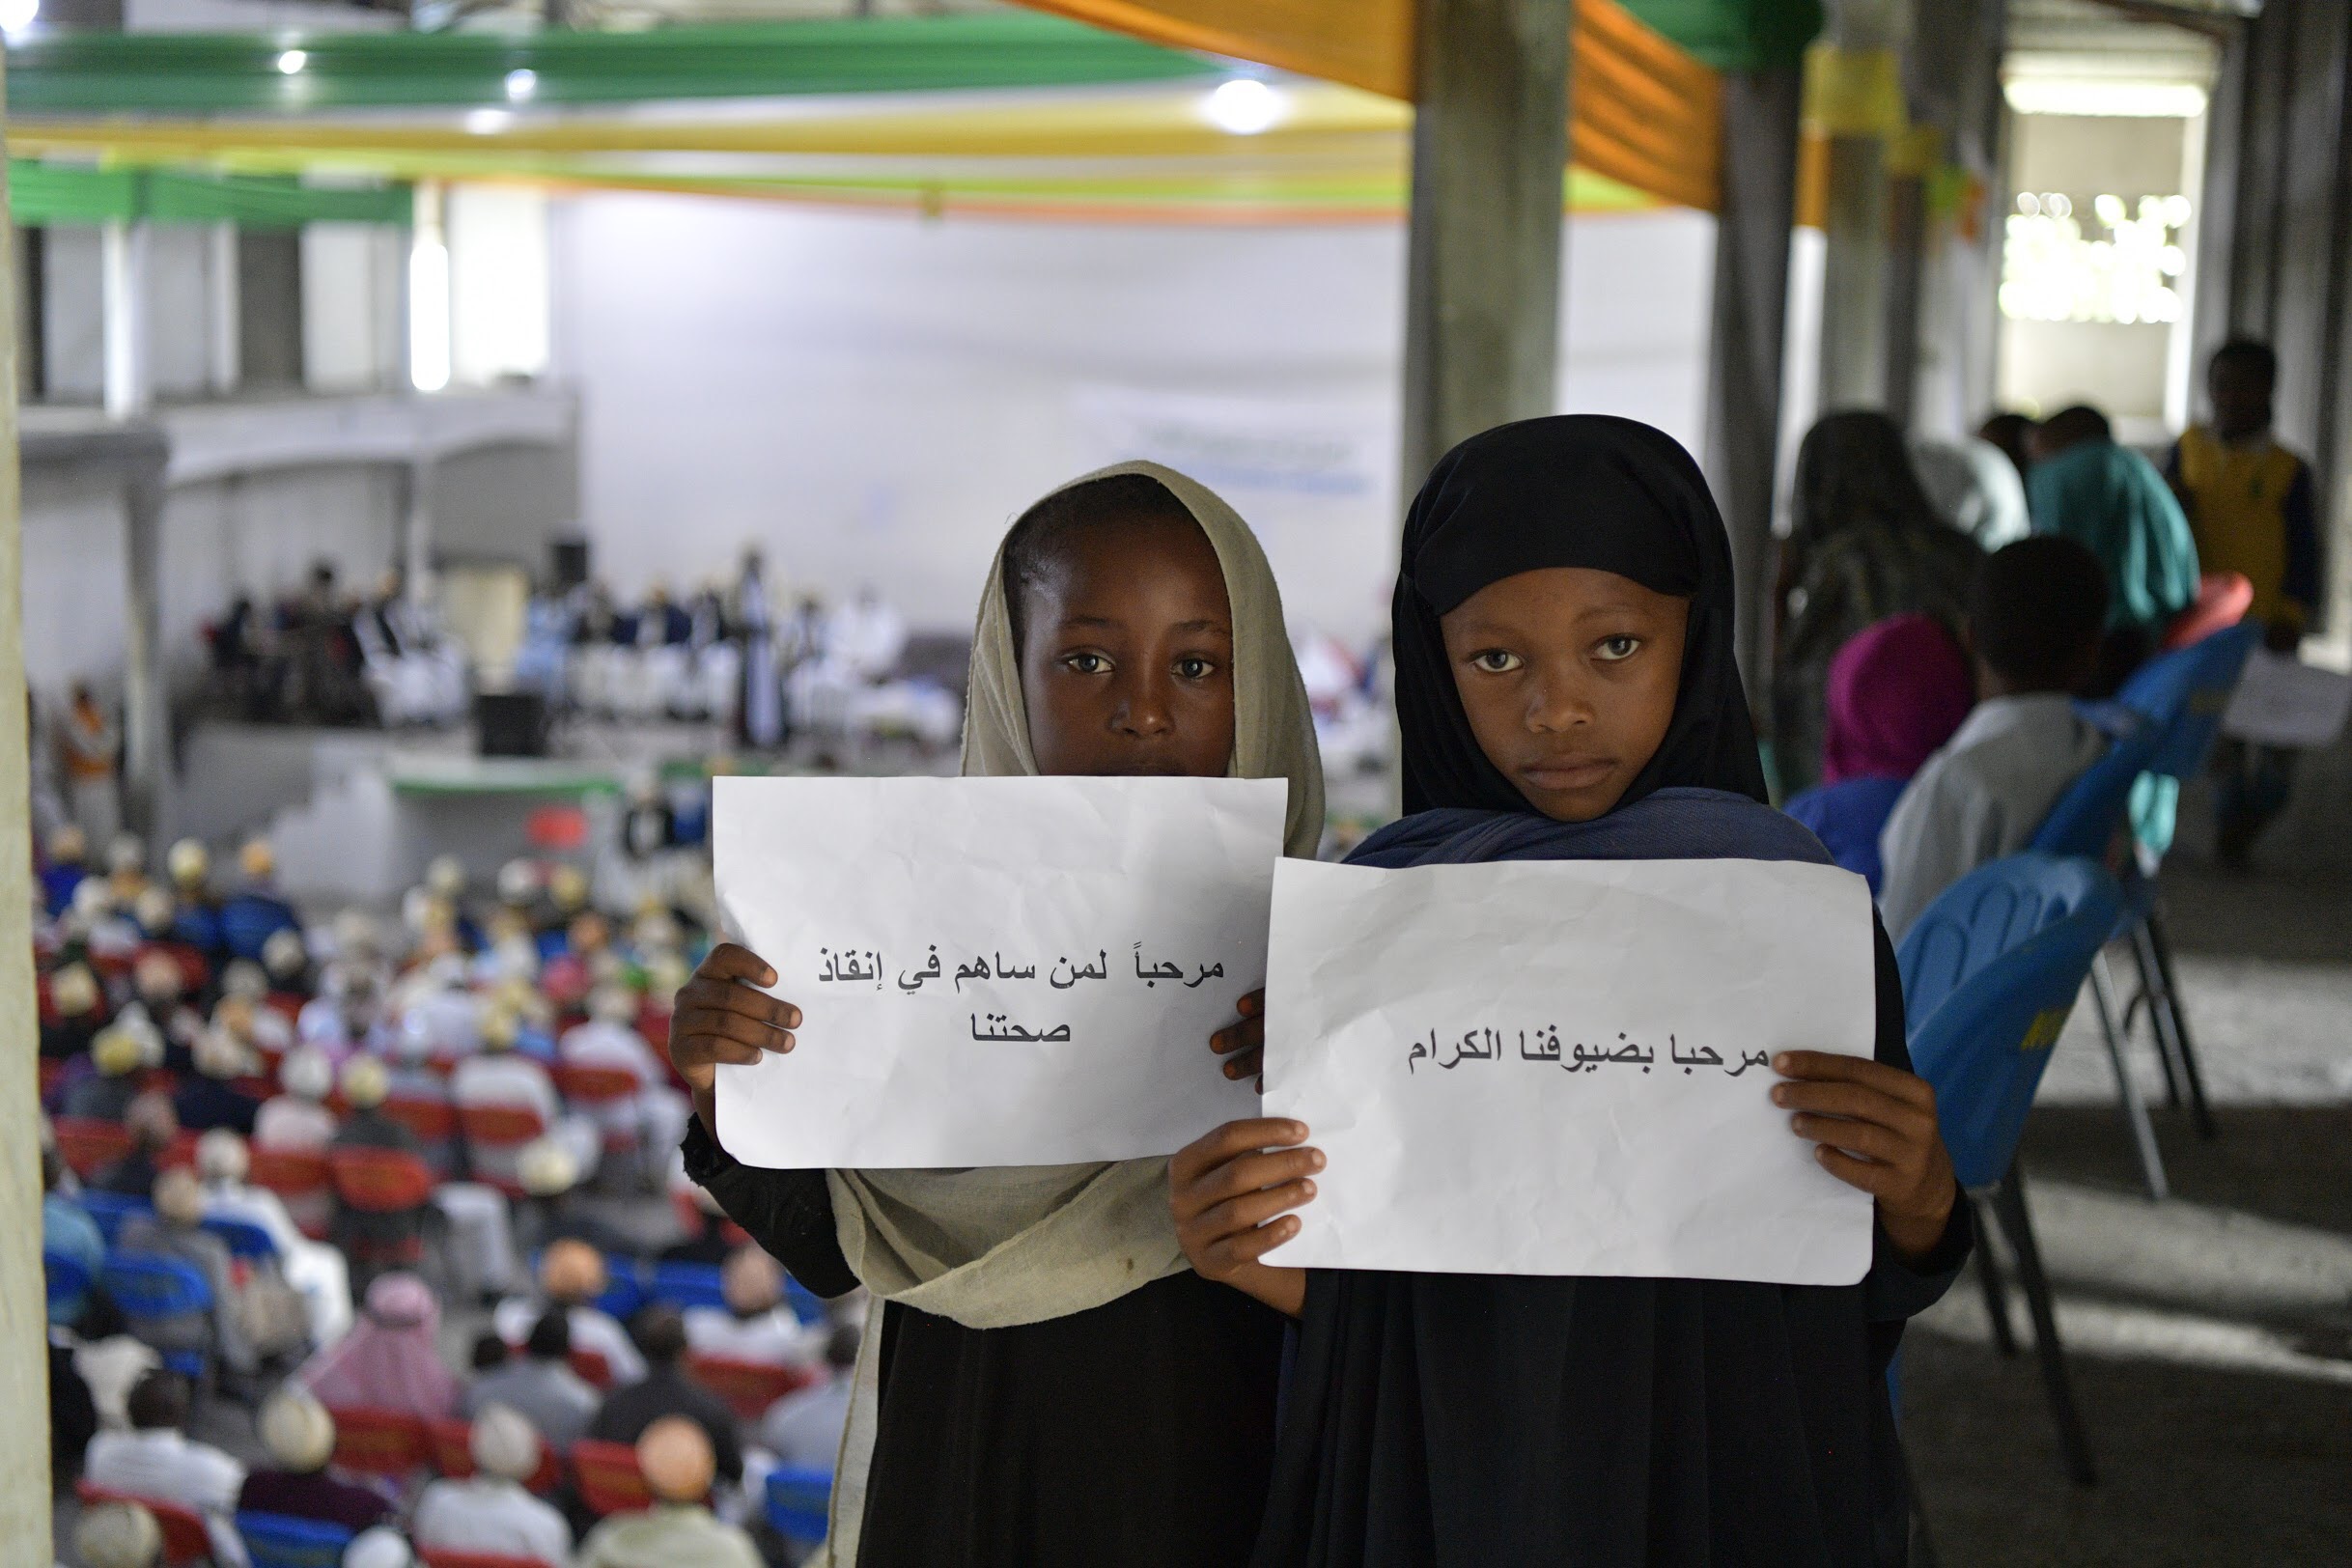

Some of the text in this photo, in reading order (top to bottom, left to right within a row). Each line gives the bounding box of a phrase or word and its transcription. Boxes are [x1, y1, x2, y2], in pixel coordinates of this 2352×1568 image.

[819, 940, 1224, 995] مرحباً لمن ساهم في إنقاذ
[970, 1013, 1071, 1043] صحتنا
[1408, 1023, 1770, 1078] مرحبا بضيوفنا الكرام
